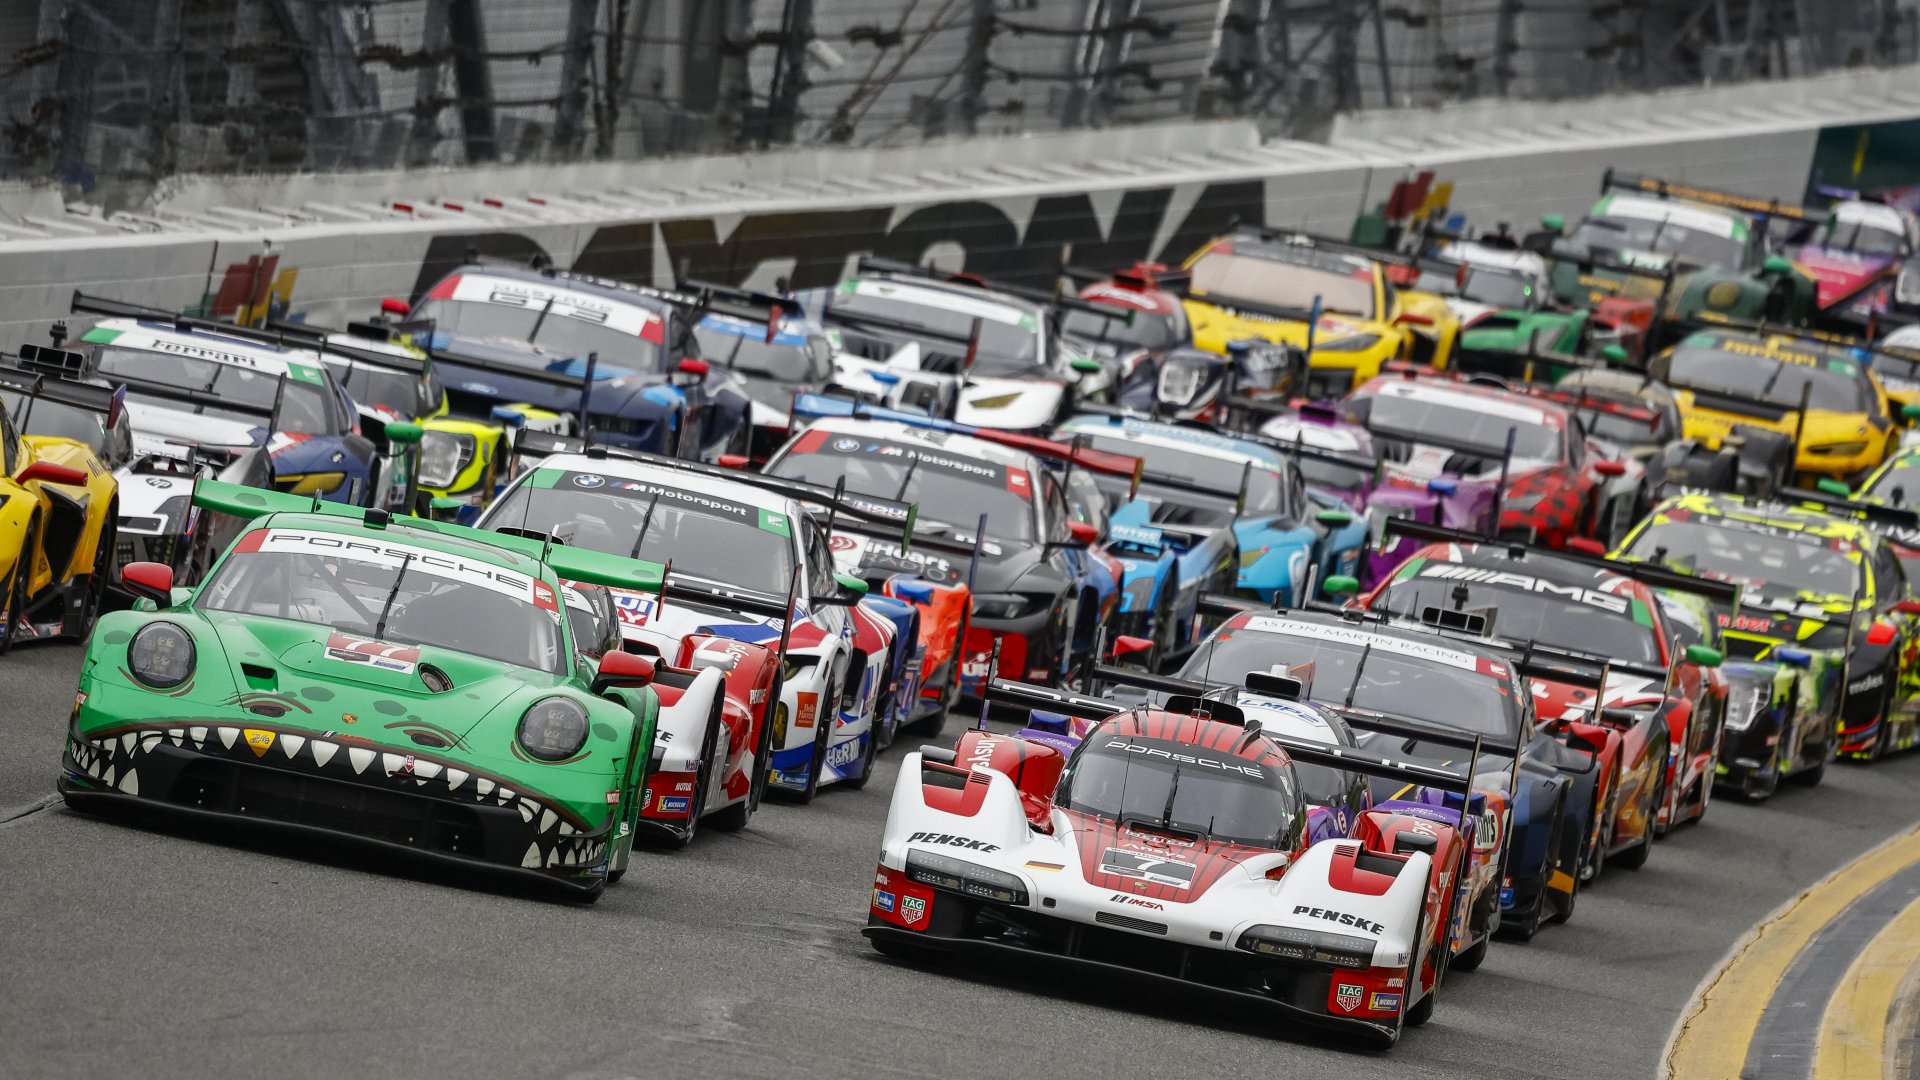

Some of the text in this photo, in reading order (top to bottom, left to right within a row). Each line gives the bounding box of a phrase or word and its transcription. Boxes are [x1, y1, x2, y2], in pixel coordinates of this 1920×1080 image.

[152, 340, 257, 368] Ferrari
[1722, 335, 1818, 368] Ferrari
[907, 449, 997, 478] Motorsport
[649, 487, 748, 516] Motorsport
[270, 534, 528, 591] PORSCHE
[1484, 571, 1628, 614] AMG
[342, 634, 410, 658] 77
[1259, 619, 1471, 664] ASTON MARTIN RACING
[1105, 741, 1264, 779] PORSCHE
[906, 832, 1001, 853] PENSKE
[901, 908, 922, 921] HEUER
[904, 898, 924, 910] TAG
[1127, 898, 1164, 911] IMSA
[1293, 905, 1385, 935] PENSKE
[1338, 996, 1361, 1010] HEUER
[1340, 986, 1361, 996] TAG
